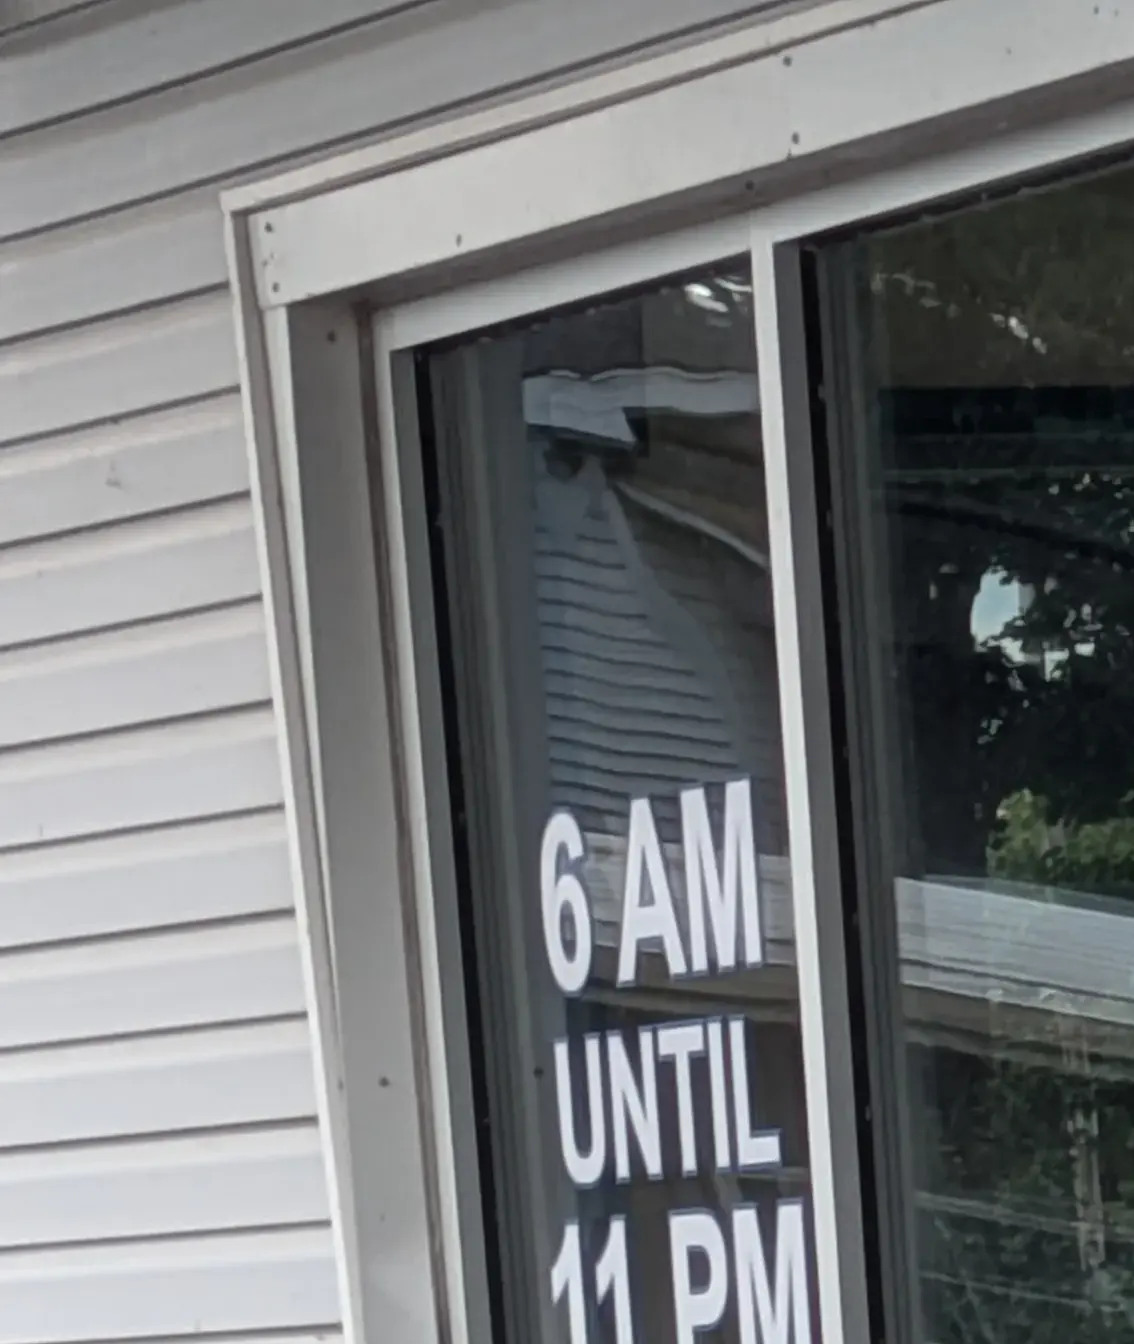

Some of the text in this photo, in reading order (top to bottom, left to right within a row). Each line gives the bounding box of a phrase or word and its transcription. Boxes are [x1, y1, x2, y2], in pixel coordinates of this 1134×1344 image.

[540, 778, 763, 994] 6 AM
[554, 1019, 782, 1185] UNTIL
